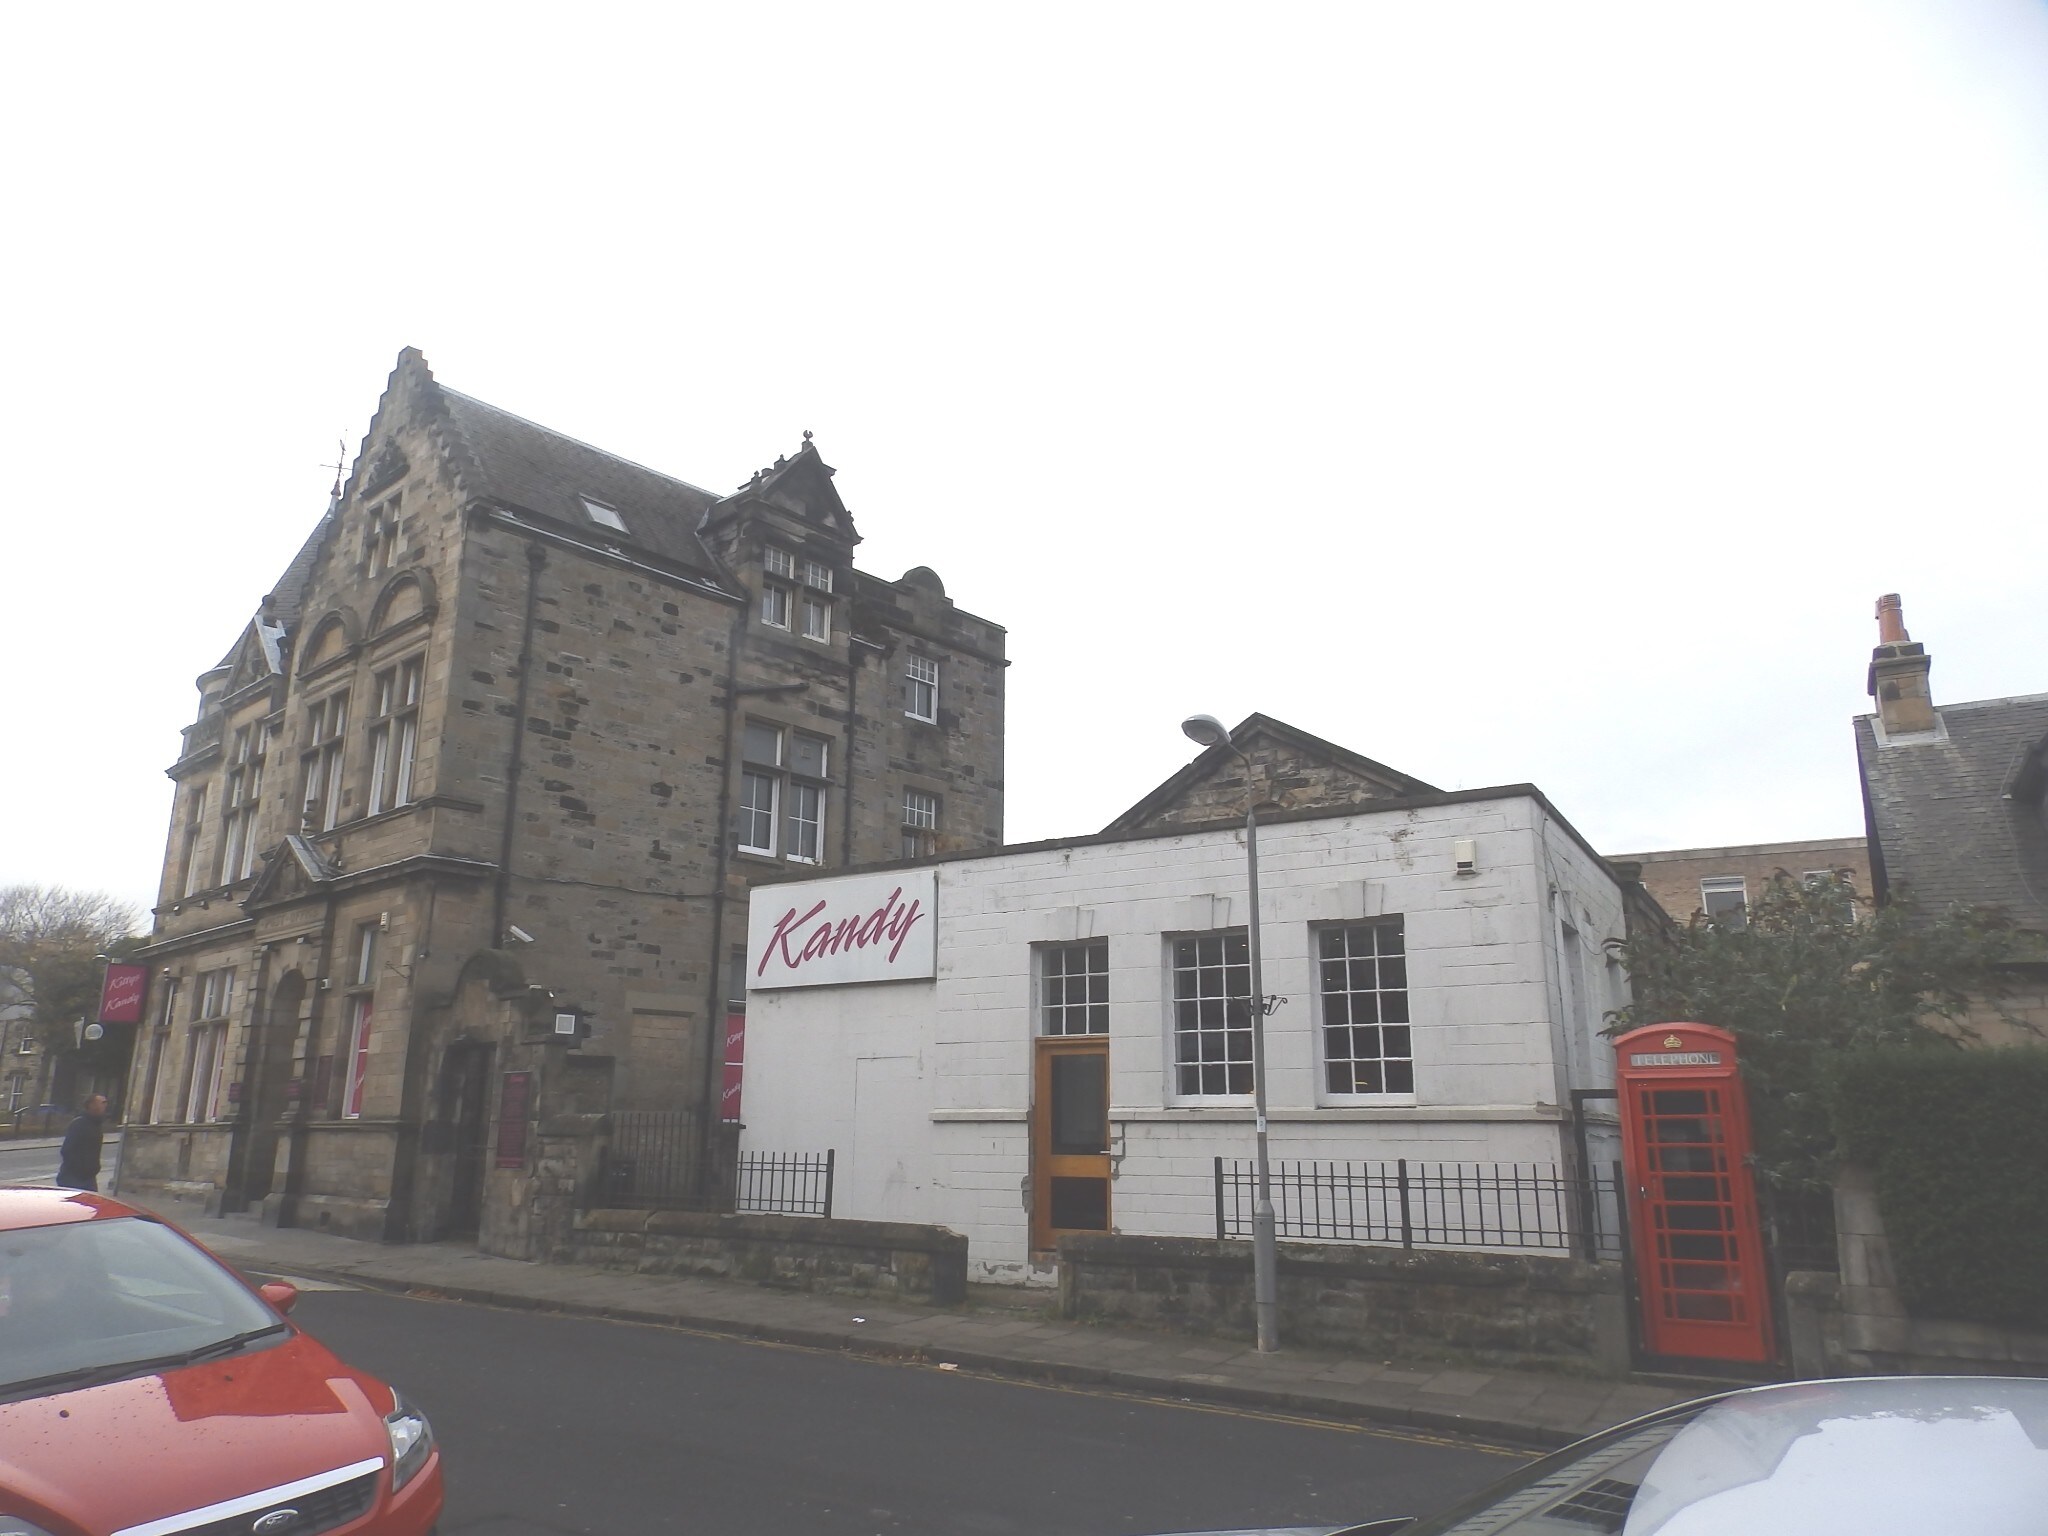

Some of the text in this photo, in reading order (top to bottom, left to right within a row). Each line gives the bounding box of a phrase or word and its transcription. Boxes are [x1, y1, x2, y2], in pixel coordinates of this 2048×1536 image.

[757, 886, 926, 977] Kandy
[105, 993, 140, 1012] Kandy
[1638, 1053, 1720, 1066] TELEPHONE
